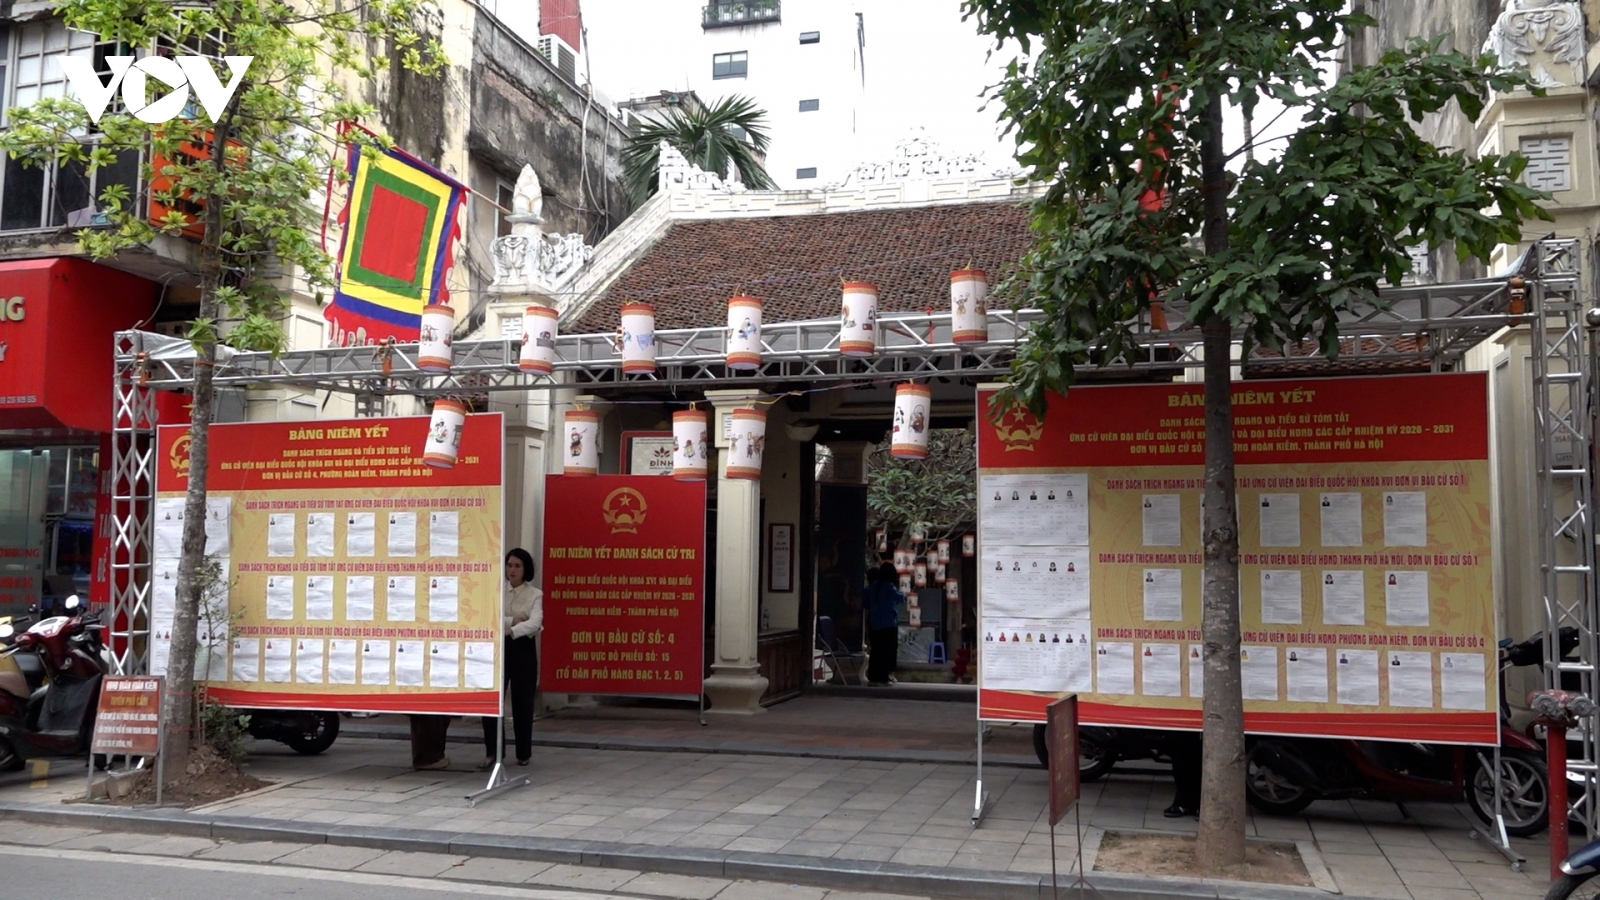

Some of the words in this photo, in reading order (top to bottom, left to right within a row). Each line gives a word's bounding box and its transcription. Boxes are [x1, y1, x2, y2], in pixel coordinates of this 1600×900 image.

[1168, 392, 1205, 407] BẢN
[1280, 386, 1316, 404] YẾT
[289, 427, 324, 440] BẢNG
[327, 426, 361, 439] NIÊM
[364, 424, 389, 438] YẾT
[650, 458, 674, 466] ĐÌNH
[550, 548, 566, 558] NƠI
[568, 546, 592, 558] NIÊM
[594, 544, 611, 559] YẾT
[614, 548, 638, 559] DANH
[641, 546, 664, 560] SÁCH
[666, 546, 678, 560] CỬ
[680, 549, 695, 560] TRI
[572, 631, 592, 643] ĐƠN
[595, 632, 605, 646] VỊ
[608, 628, 628, 644] BẦU
[632, 628, 645, 644] CỬ
[648, 628, 664, 644] SỐ:
[668, 633, 674, 644] 4
[574, 652, 588, 660] KHU
[591, 651, 606, 662] VỰC
[608, 650, 618, 661] BỎ
[621, 649, 643, 662] PHIẾU
[646, 650, 658, 662] SỐ:
[662, 653, 670, 662] 15
